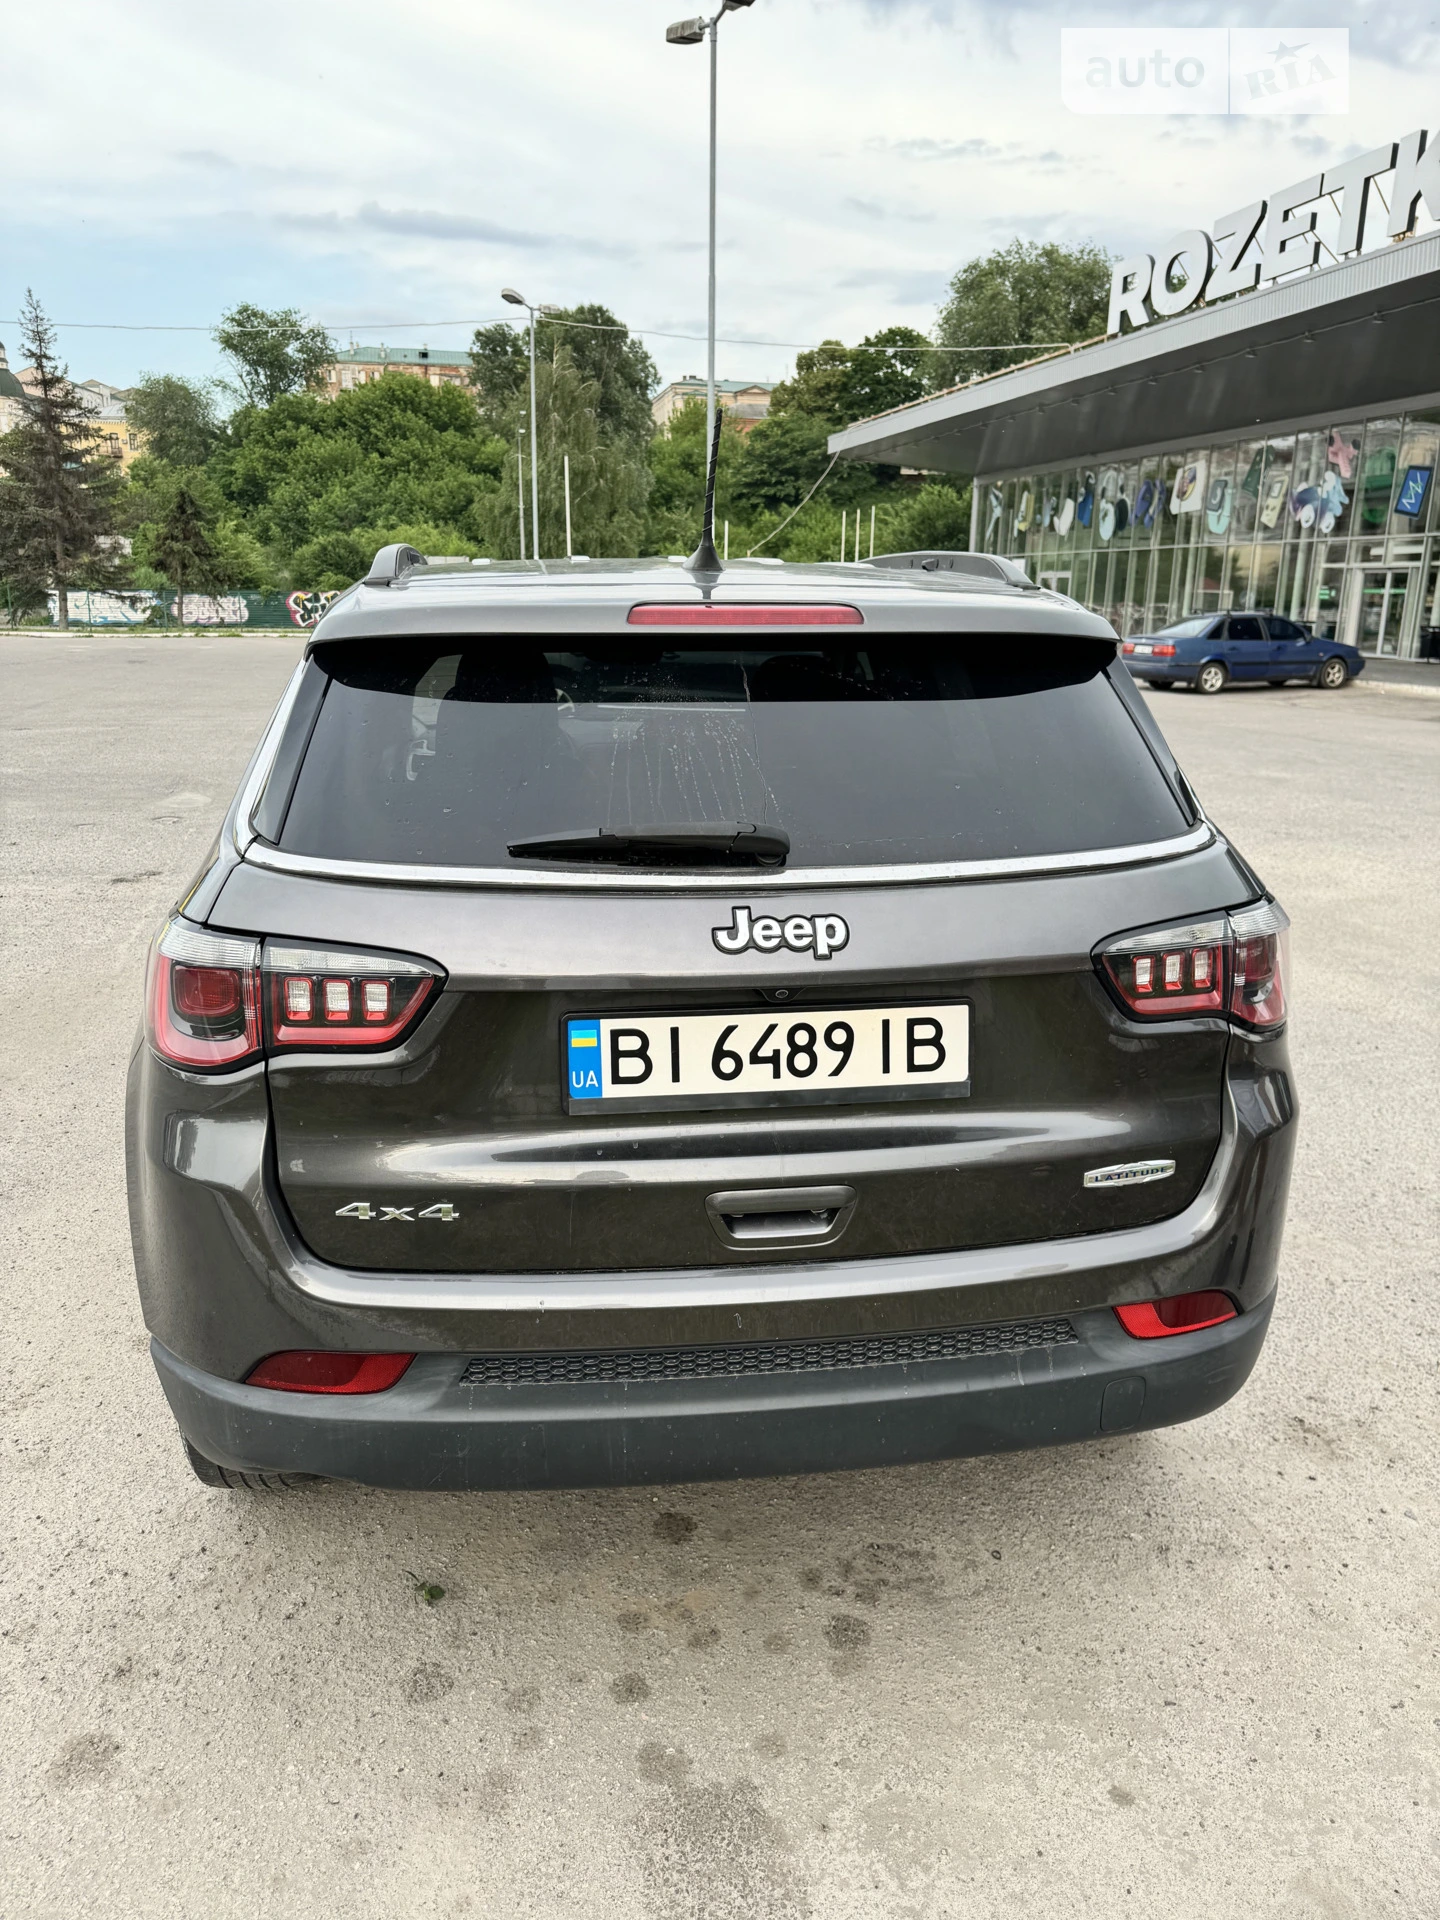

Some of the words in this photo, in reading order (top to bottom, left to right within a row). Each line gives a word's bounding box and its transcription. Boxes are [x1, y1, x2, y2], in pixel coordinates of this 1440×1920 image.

[1107, 129, 1440, 335] ROZETK
[713, 907, 849, 959] Jeep
[609, 1026, 681, 1086] BI
[711, 1021, 855, 1081] 6489
[881, 1017, 947, 1075] IB
[572, 1071, 598, 1088] UA
[1094, 1167, 1168, 1182] LATITUDE
[335, 1202, 460, 1221] 4x4
